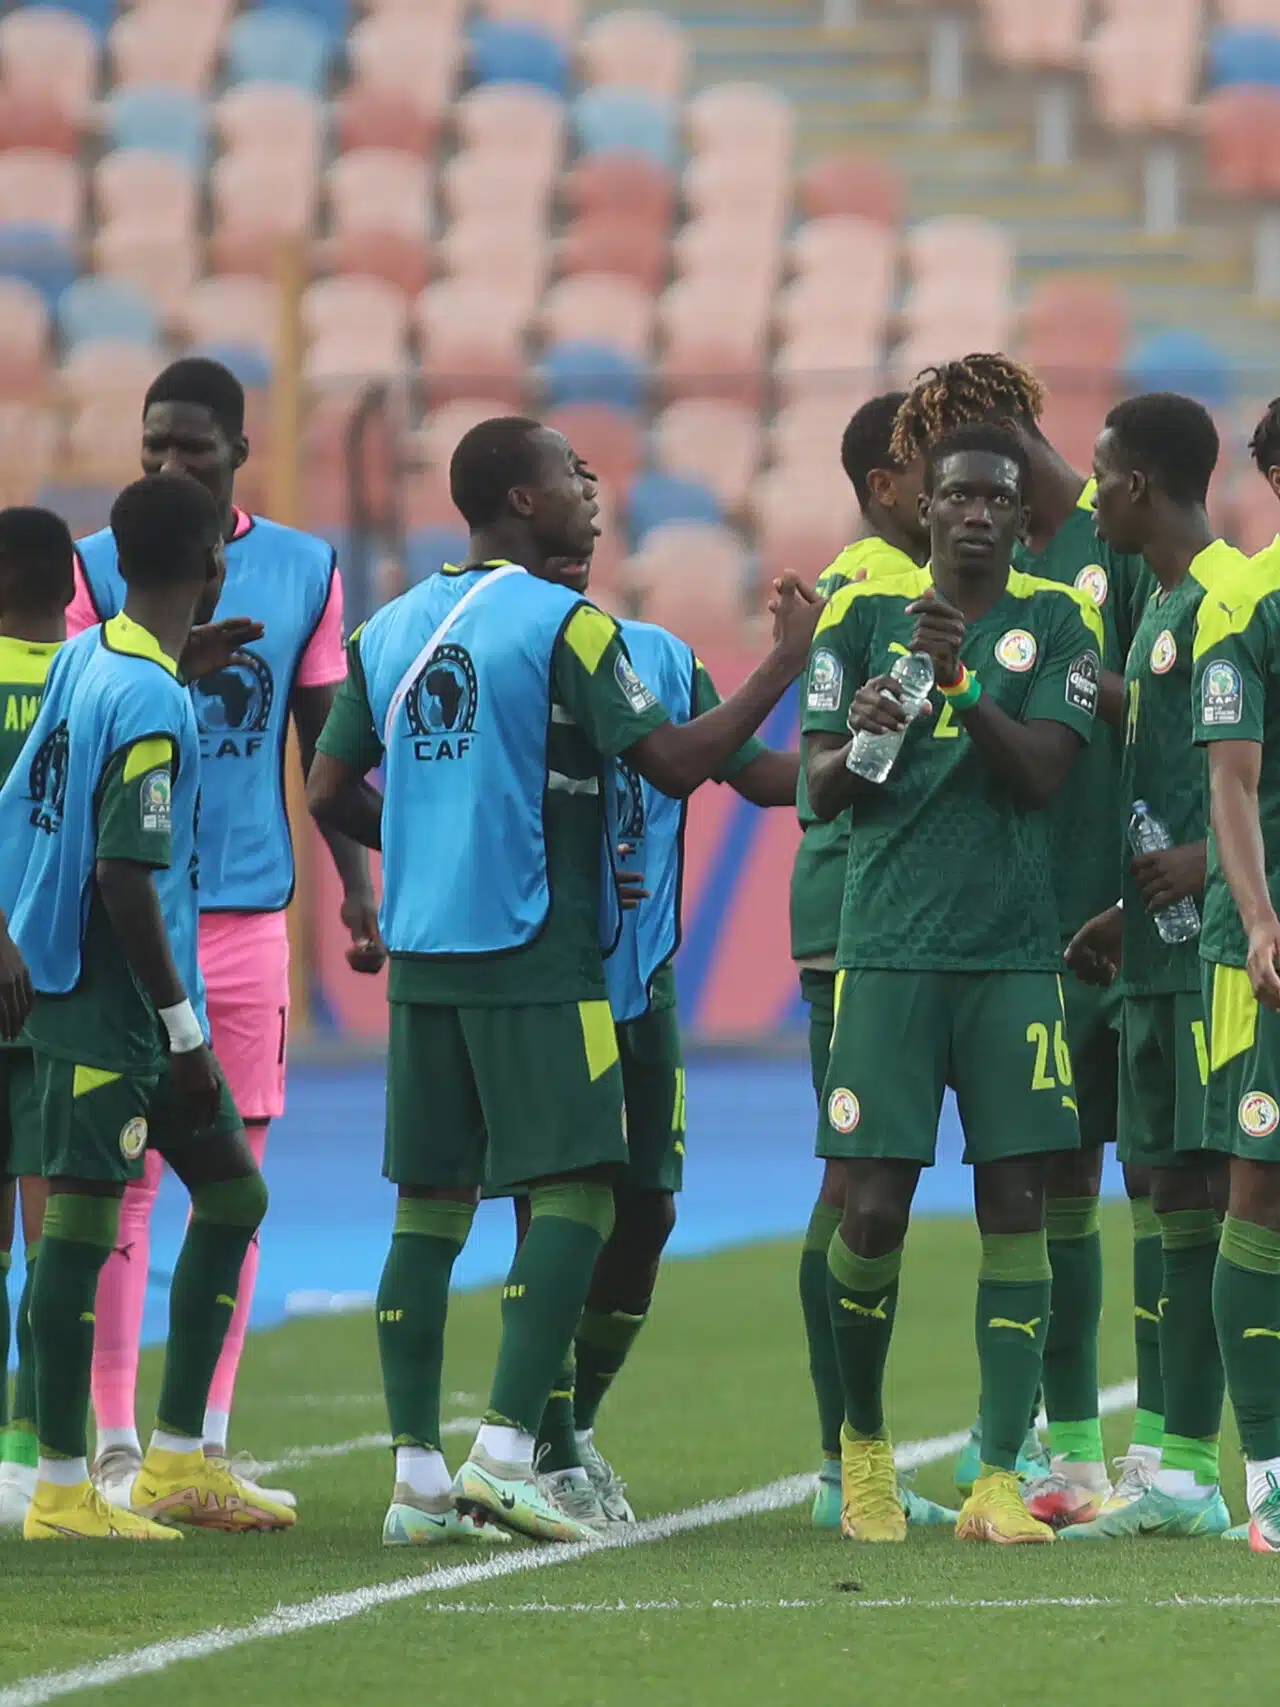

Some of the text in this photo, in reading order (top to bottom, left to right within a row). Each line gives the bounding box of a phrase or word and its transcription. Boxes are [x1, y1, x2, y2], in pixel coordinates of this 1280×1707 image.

[4, 694, 42, 732] AM
[414, 737, 470, 761] CAF
[1026, 1020, 1072, 1091] 26
